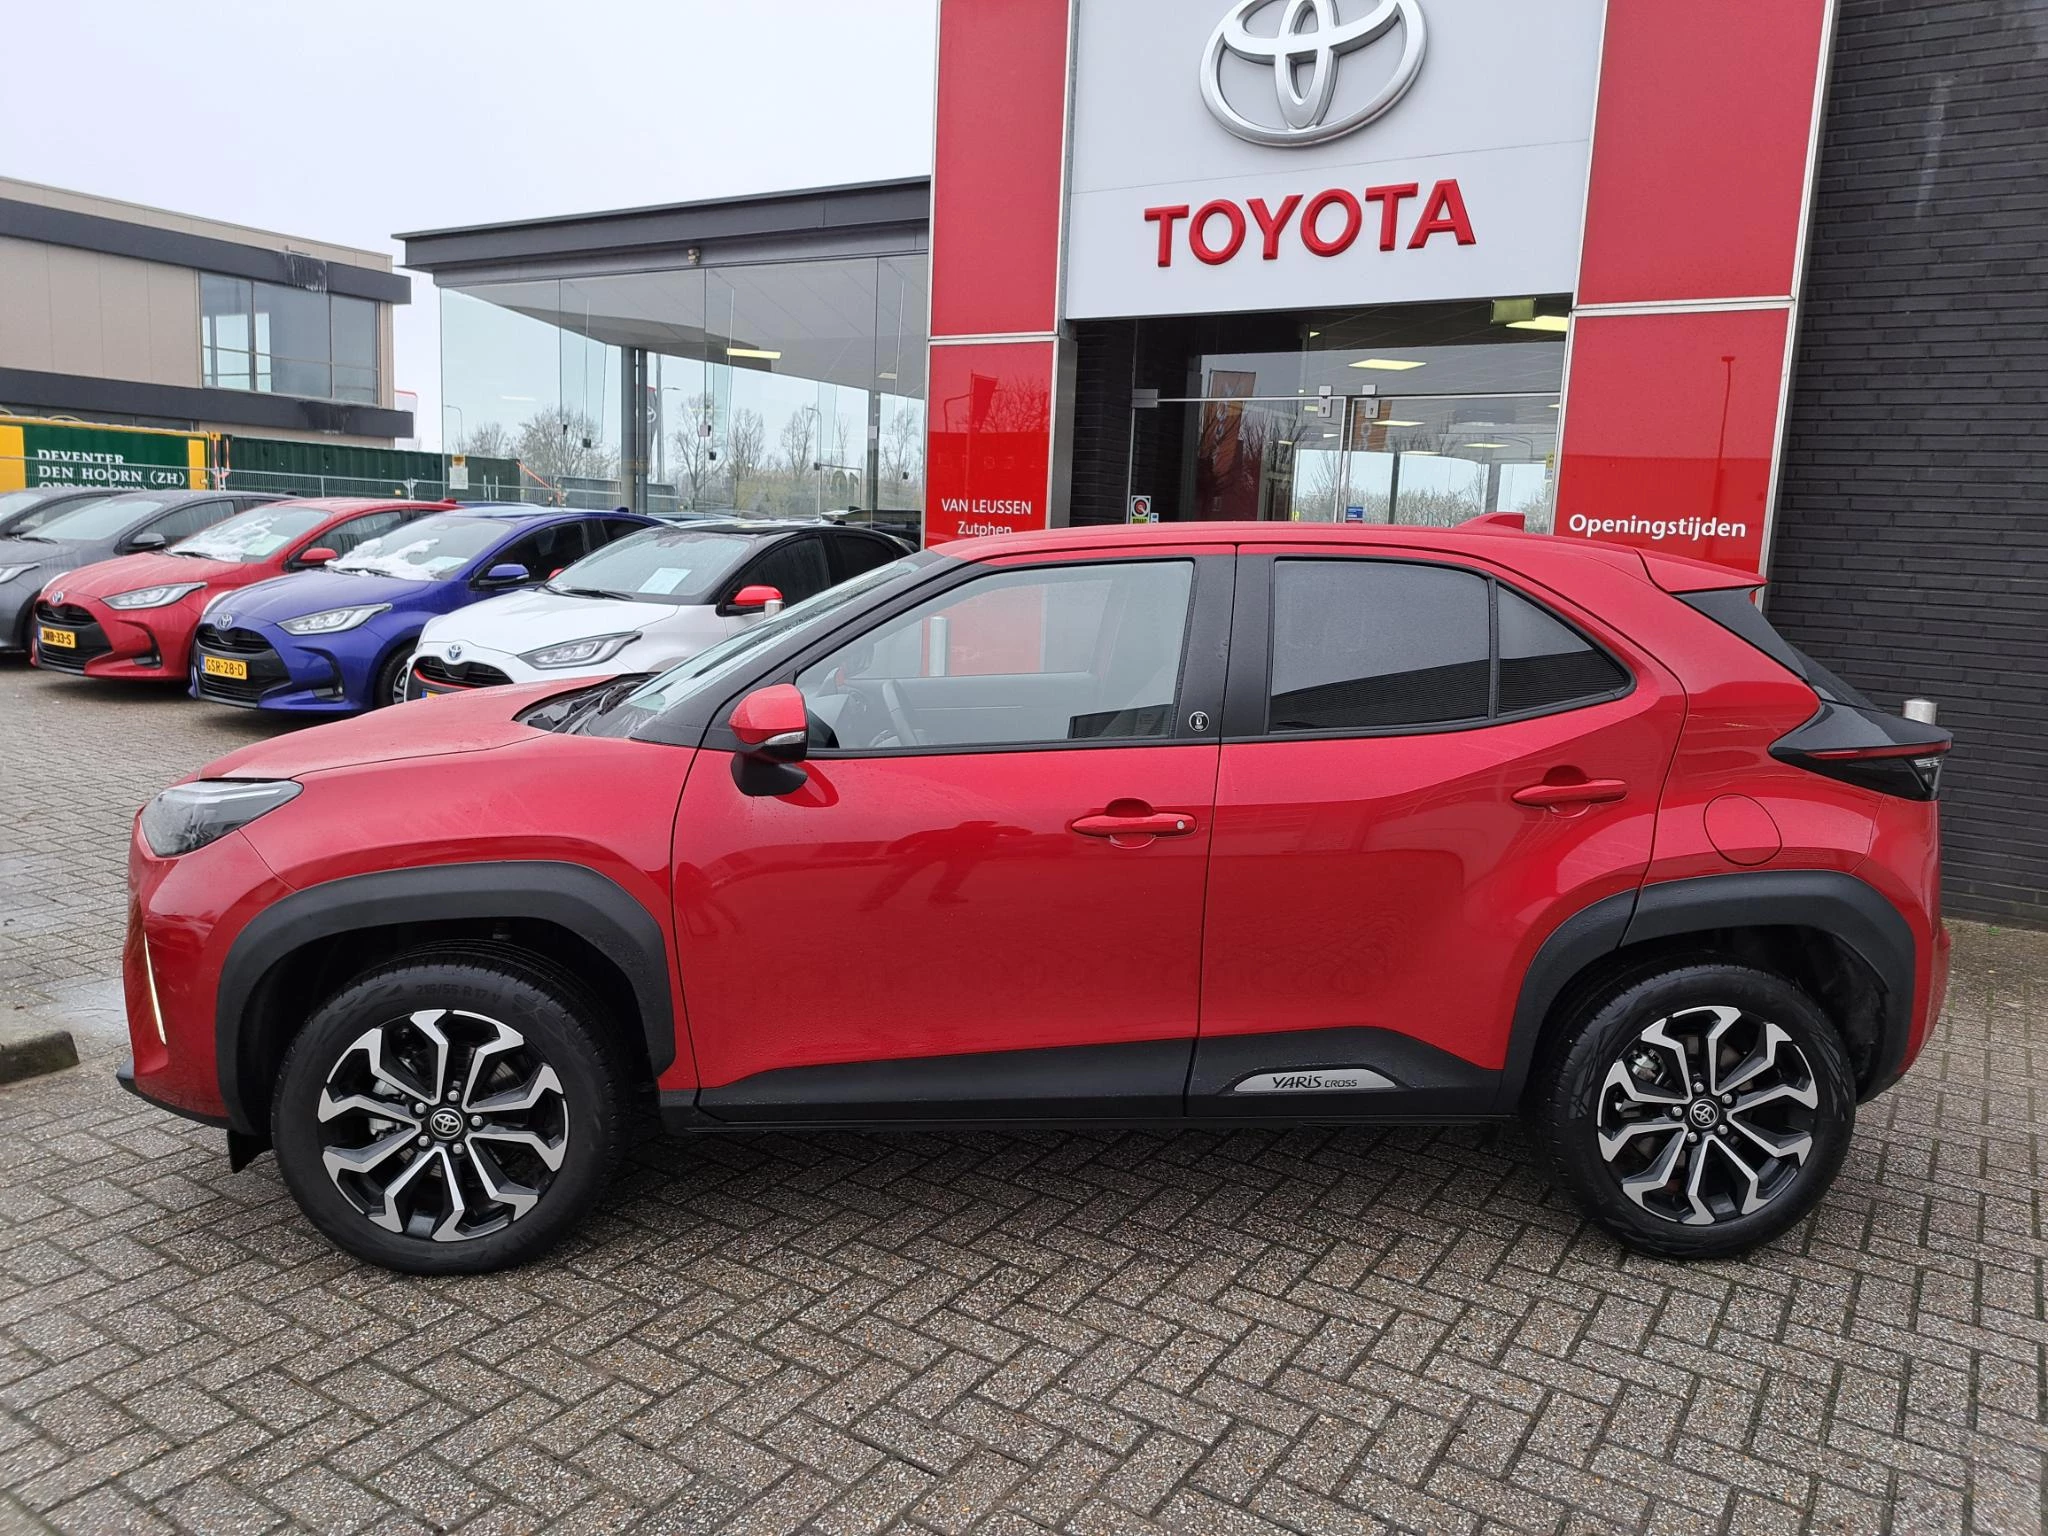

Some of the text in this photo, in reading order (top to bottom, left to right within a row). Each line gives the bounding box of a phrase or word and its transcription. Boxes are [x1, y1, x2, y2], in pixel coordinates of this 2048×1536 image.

[1144, 178, 1477, 267] TOYOTA
[37, 449, 125, 465] DEVENTER
[38, 465, 74, 479] DEN
[82, 468, 142, 482] HOORN
[150, 470, 185, 486] (ZH)
[941, 498, 1032, 515] VAN LEUSSEN
[957, 520, 1012, 537] Zutphen
[1569, 513, 1747, 541] Openingstijden
[1324, 1079, 1358, 1088] CROSS
